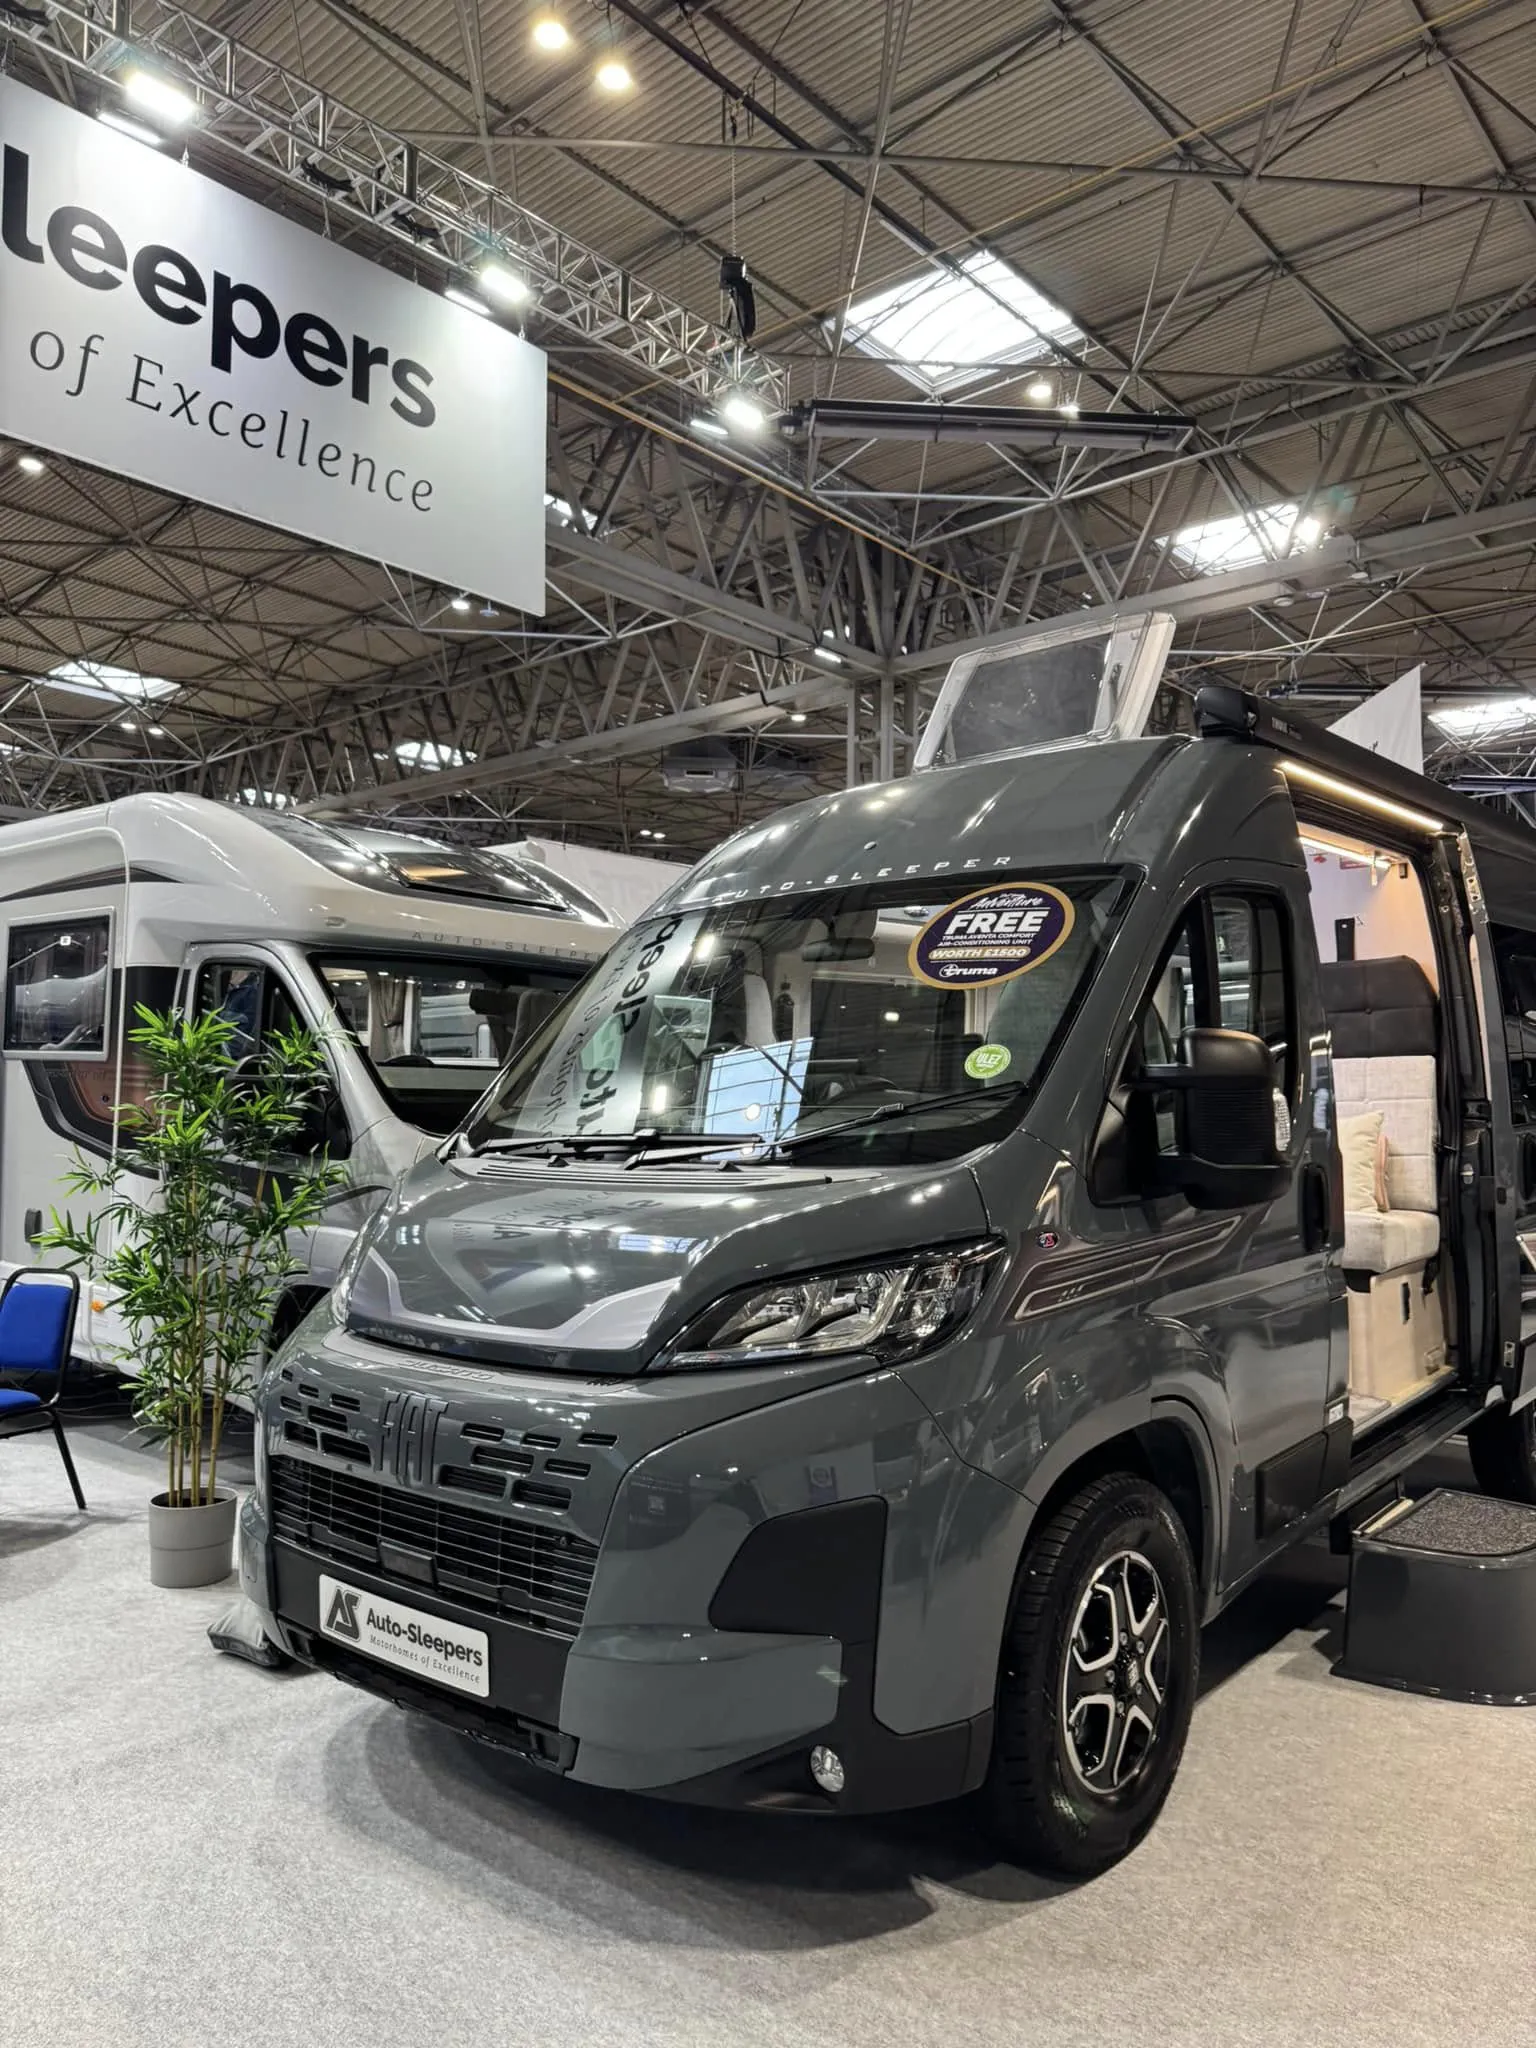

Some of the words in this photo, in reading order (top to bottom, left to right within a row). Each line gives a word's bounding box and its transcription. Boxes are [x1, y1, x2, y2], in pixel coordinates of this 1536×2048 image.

[2, 143, 437, 429] leepers
[29, 328, 104, 397] of
[126, 353, 434, 512] Excellence
[944, 911, 1050, 935] FREE
[933, 949, 983, 959] WORTH
[941, 964, 998, 977] truma
[374, 1388, 449, 1486] FIAT
[366, 1607, 483, 1667] Auto-Sleepers
[369, 1634, 418, 1662] Motorhomes
[421, 1656, 430, 1668] of
[432, 1659, 481, 1684] Excellence
